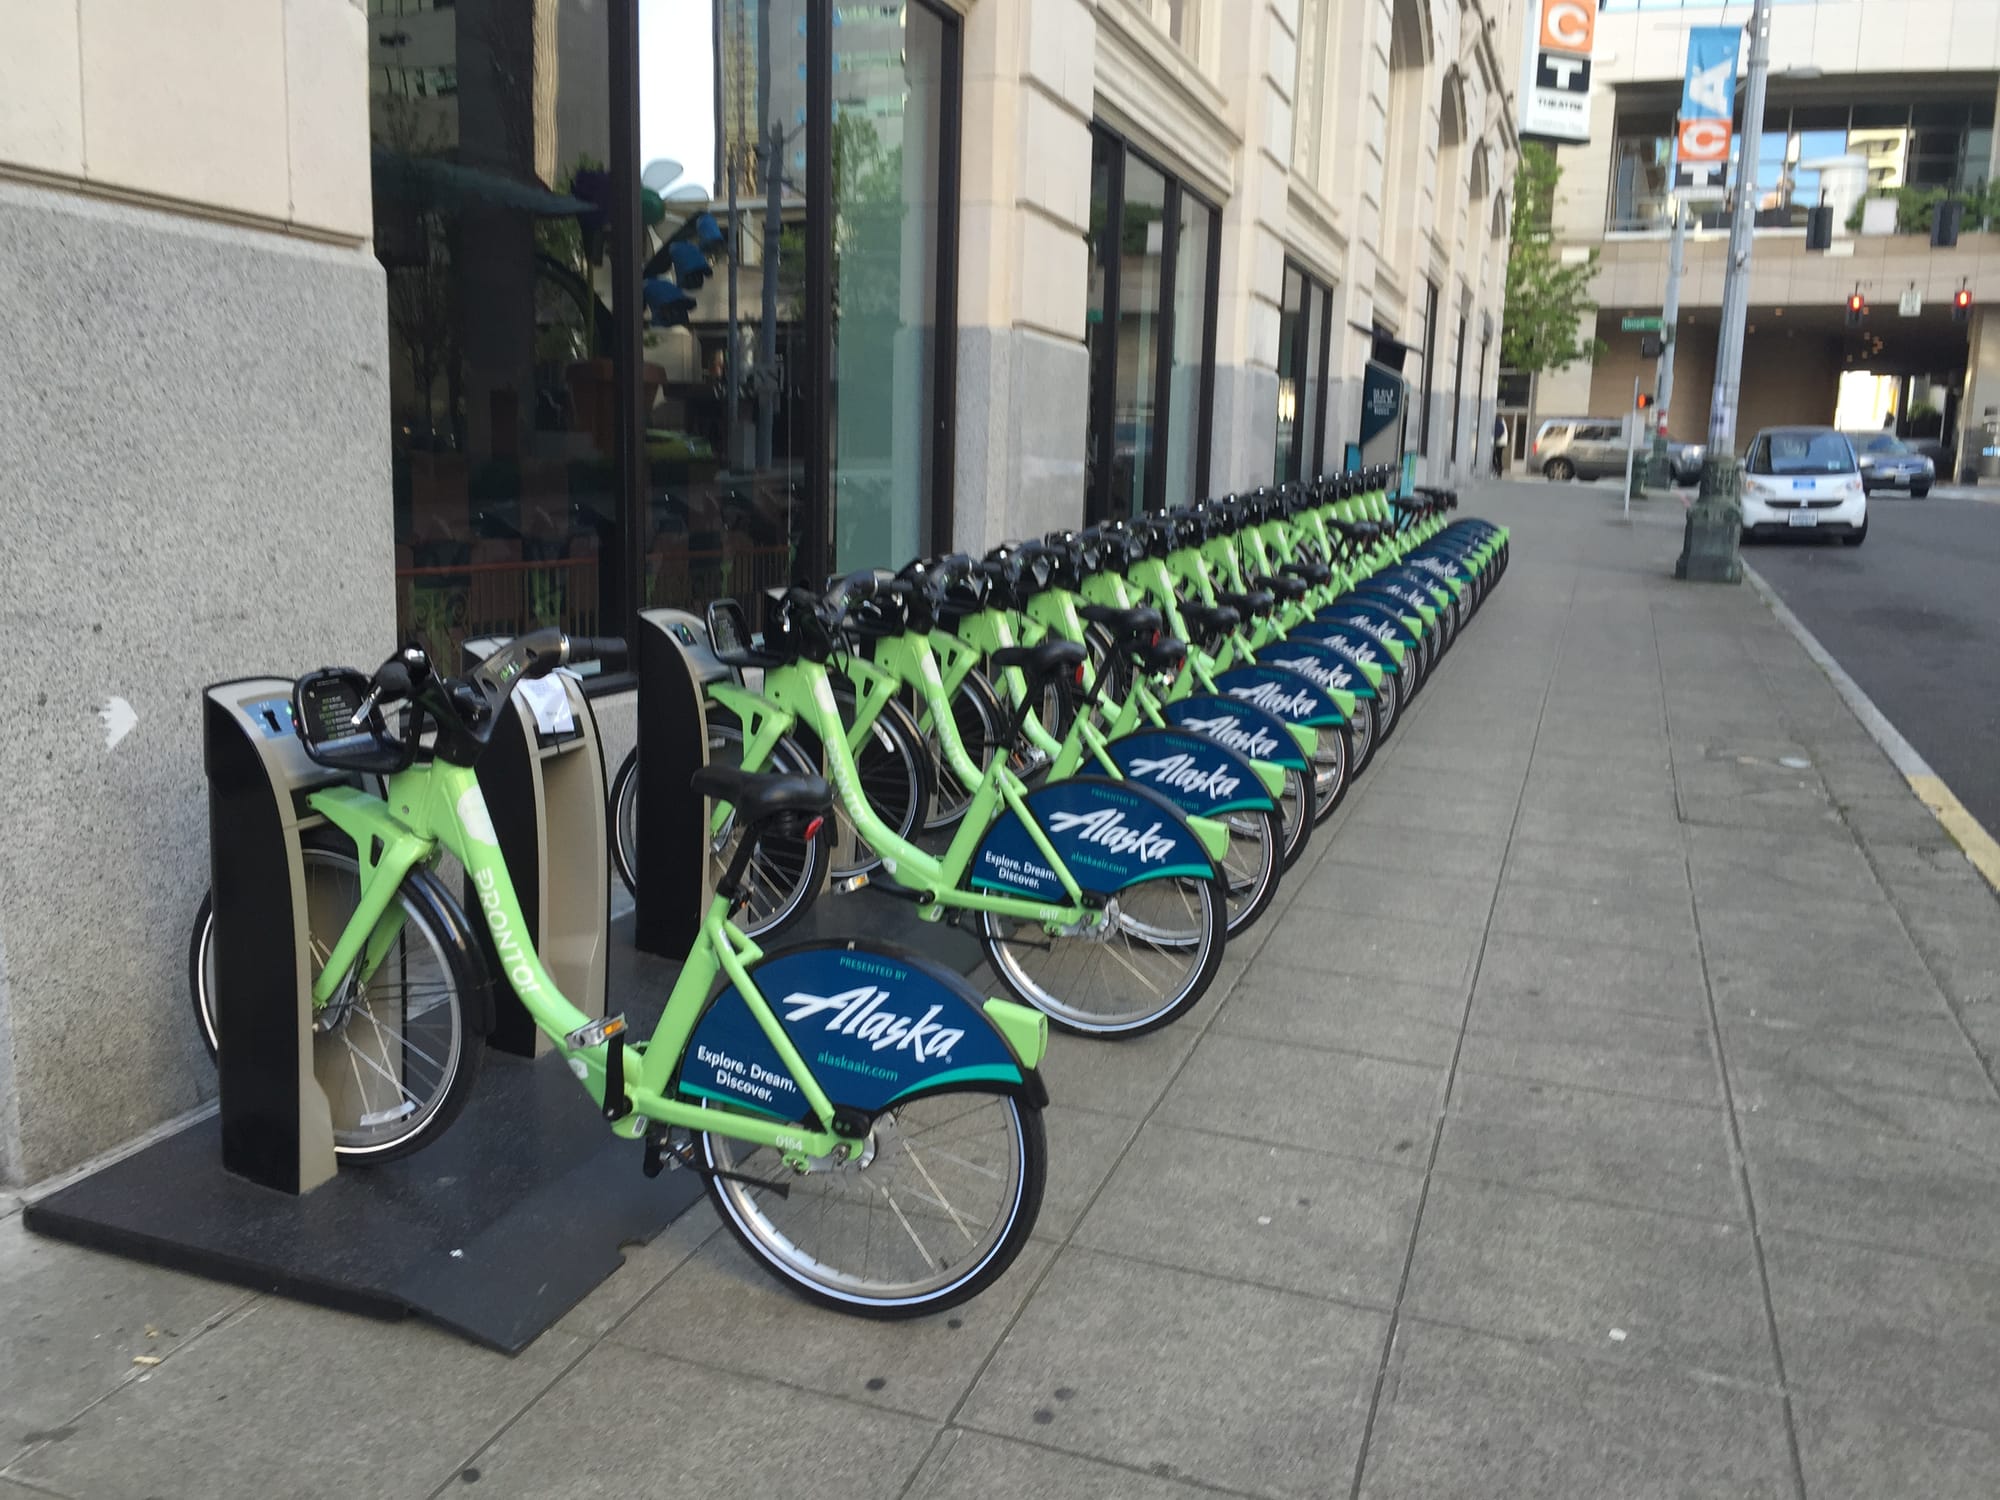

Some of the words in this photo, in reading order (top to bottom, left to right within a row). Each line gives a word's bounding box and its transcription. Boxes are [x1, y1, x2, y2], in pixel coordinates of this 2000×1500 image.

[1273, 655, 1352, 689] Alaska
[1229, 681, 1317, 718] Alaska
[1181, 715, 1278, 758] Alaska
[1129, 753, 1240, 800] Alaska
[1049, 808, 1176, 863] Alaska
[474, 866, 541, 994] PRONTO!
[840, 956, 893, 978] PRESENTED
[895, 969, 908, 981] BY
[782, 985, 966, 1064] Alaska
[817, 1050, 899, 1081] alaskaair.com
